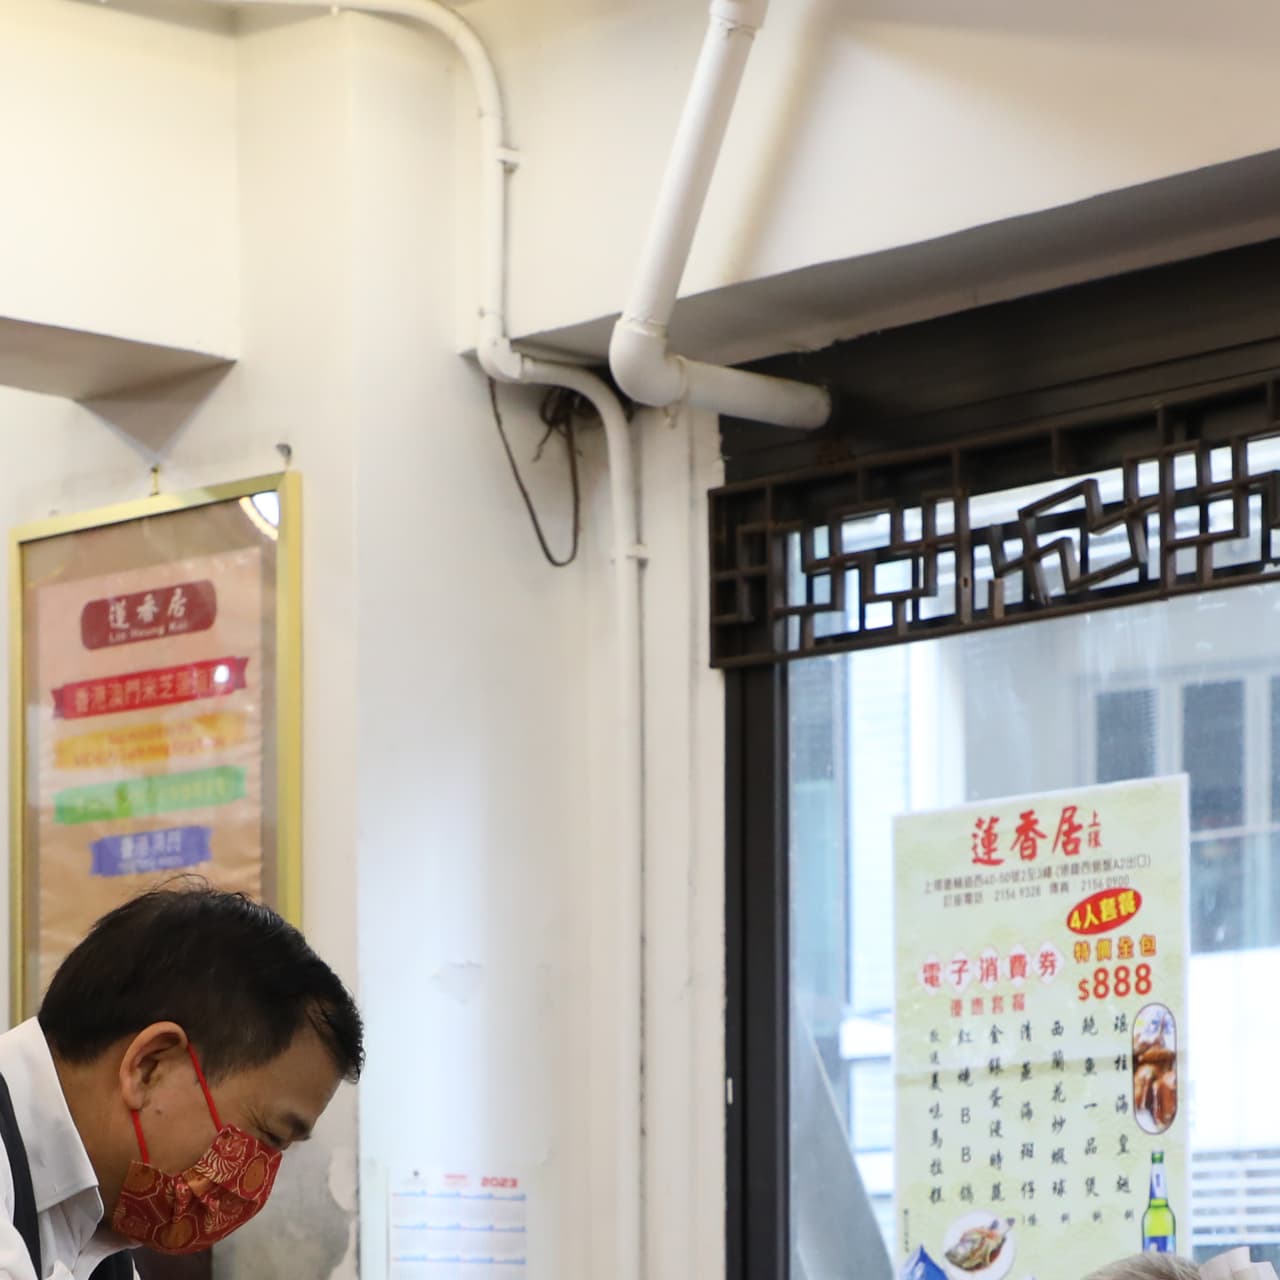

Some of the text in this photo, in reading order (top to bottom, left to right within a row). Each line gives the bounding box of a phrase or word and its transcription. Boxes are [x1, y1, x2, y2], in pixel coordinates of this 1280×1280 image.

[108, 587, 188, 630] 蓮香居
[971, 805, 1085, 866] 蓮香居
[1070, 889, 1136, 930] 4人套餐
[923, 951, 1057, 988] 電子消費券
[1079, 963, 1152, 1001] $888
